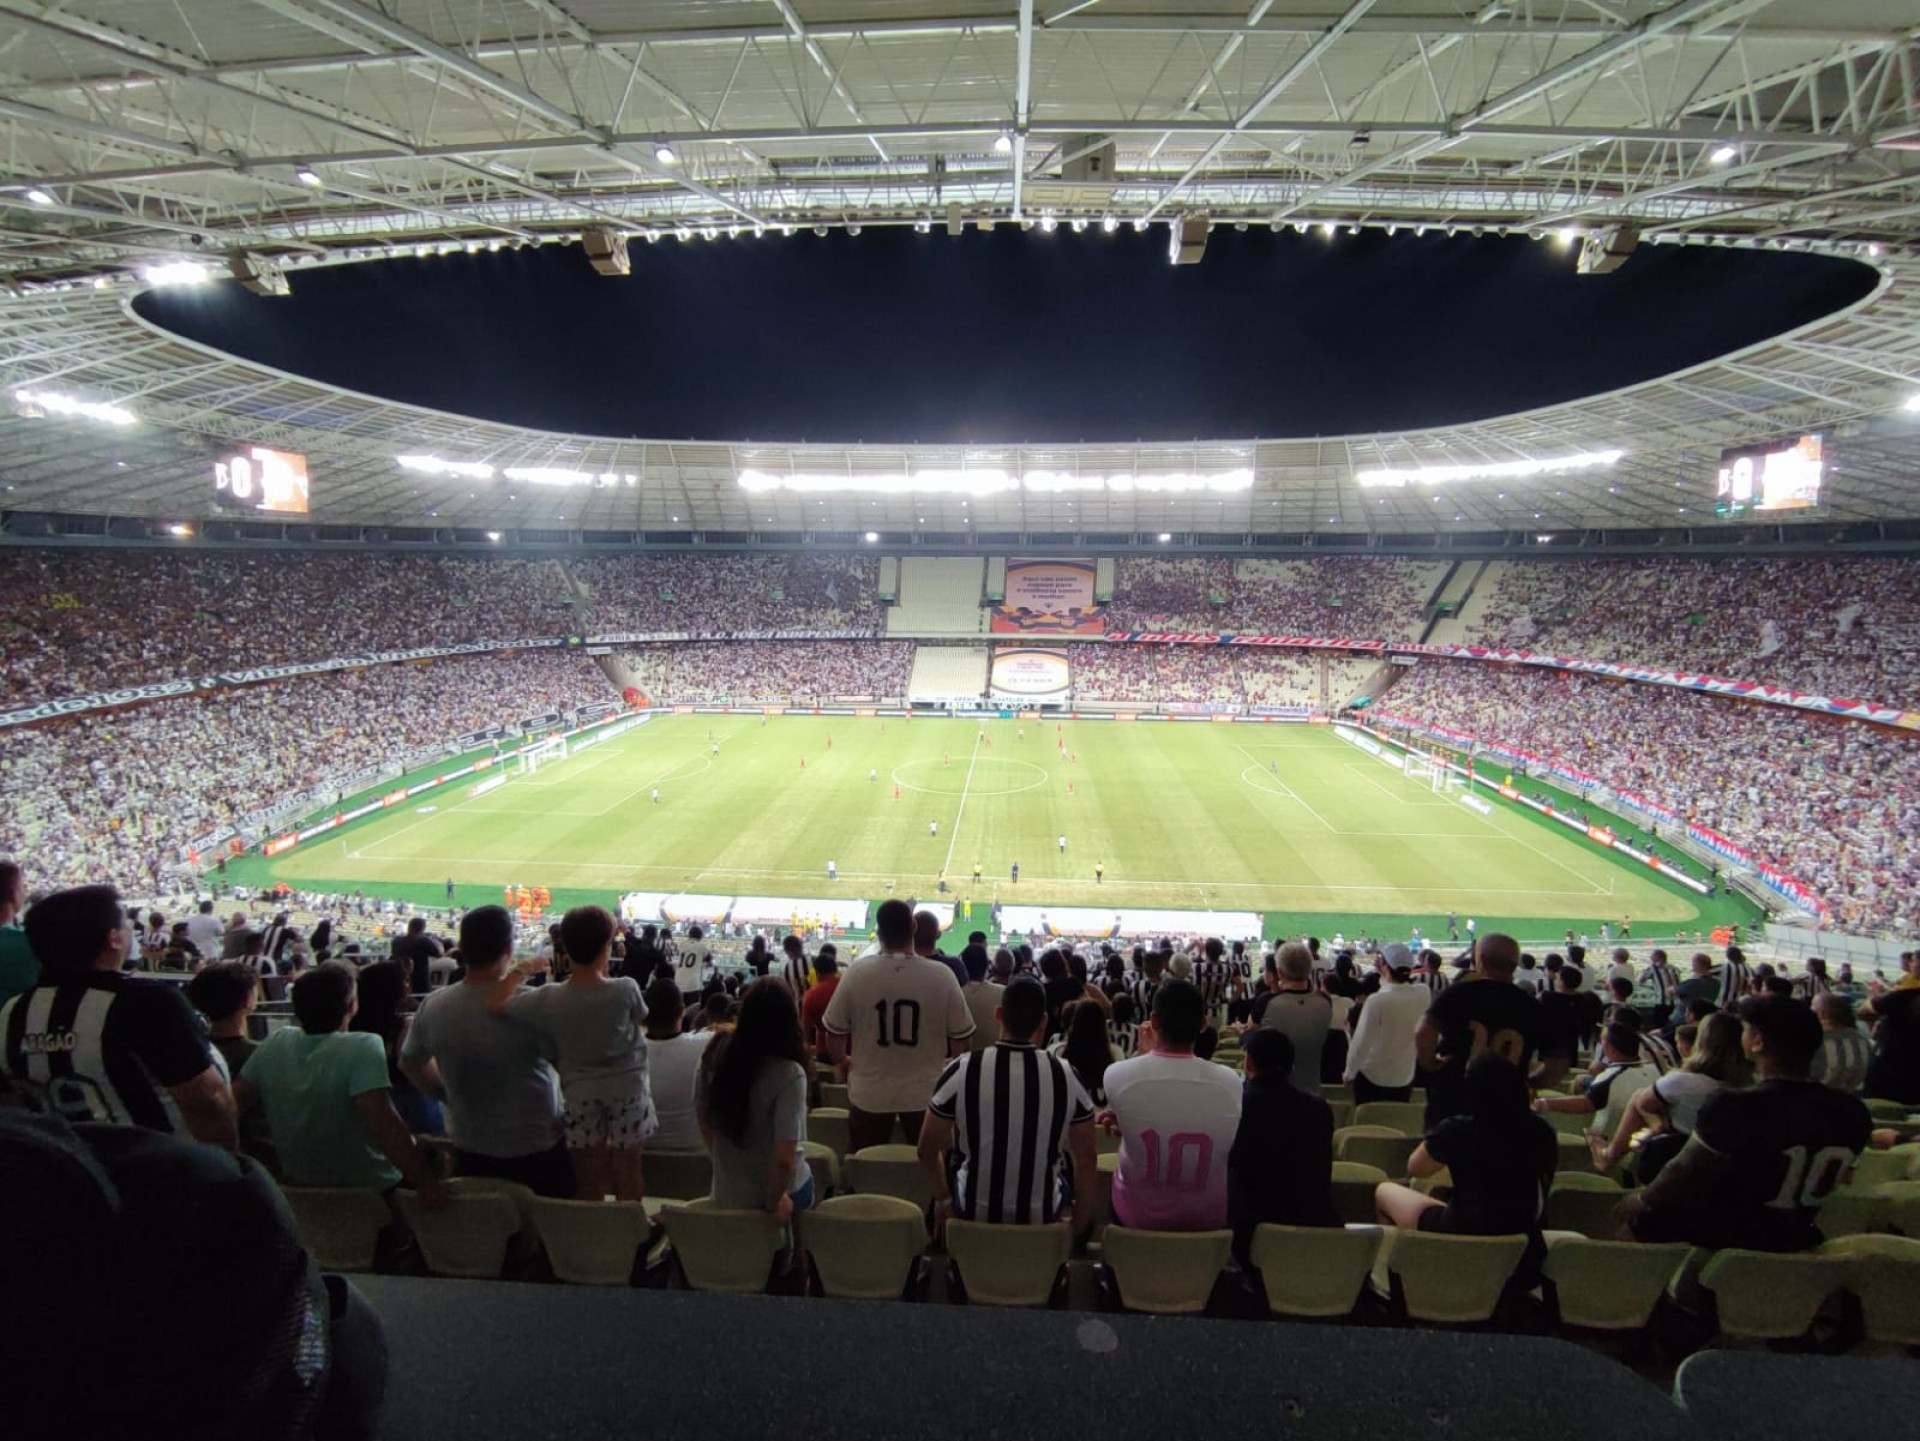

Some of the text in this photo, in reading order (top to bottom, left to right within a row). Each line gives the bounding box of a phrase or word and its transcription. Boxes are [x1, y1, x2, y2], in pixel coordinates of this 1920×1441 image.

[1744, 685, 1832, 711] AMOR
[679, 952, 697, 968] 10
[875, 999, 920, 1047] 10
[1140, 1129, 1213, 1193] 10
[1763, 1145, 1857, 1210] 10
